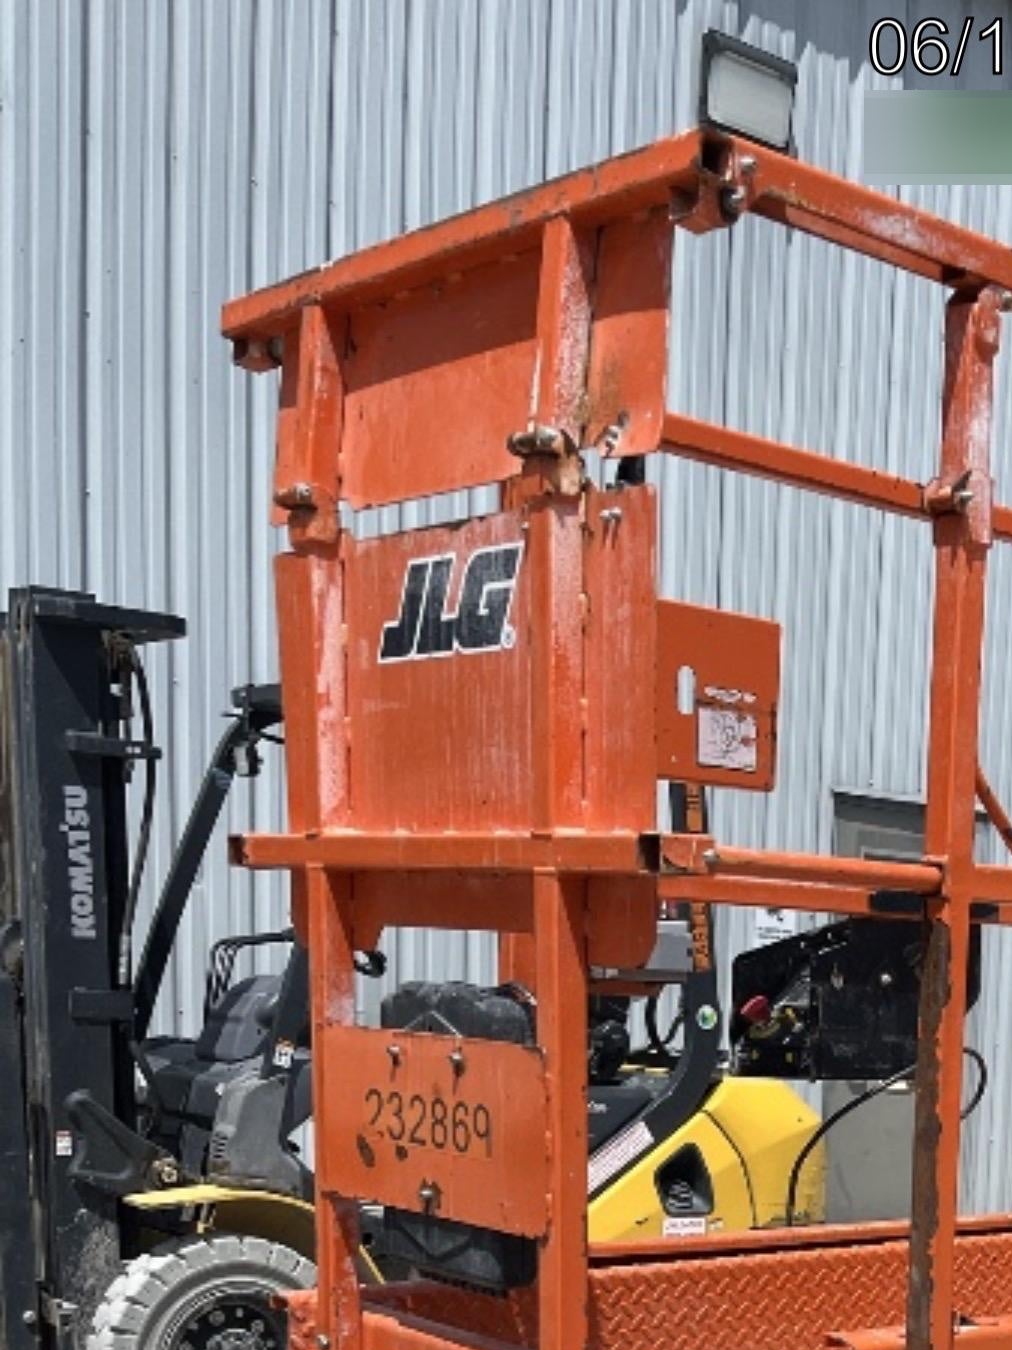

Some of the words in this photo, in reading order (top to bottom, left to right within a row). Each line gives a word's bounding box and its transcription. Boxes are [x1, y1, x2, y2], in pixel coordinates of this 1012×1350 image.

[378, 541, 524, 663] JLG
[59, 784, 96, 939] KOMATSU
[365, 1088, 493, 1158] 232869
